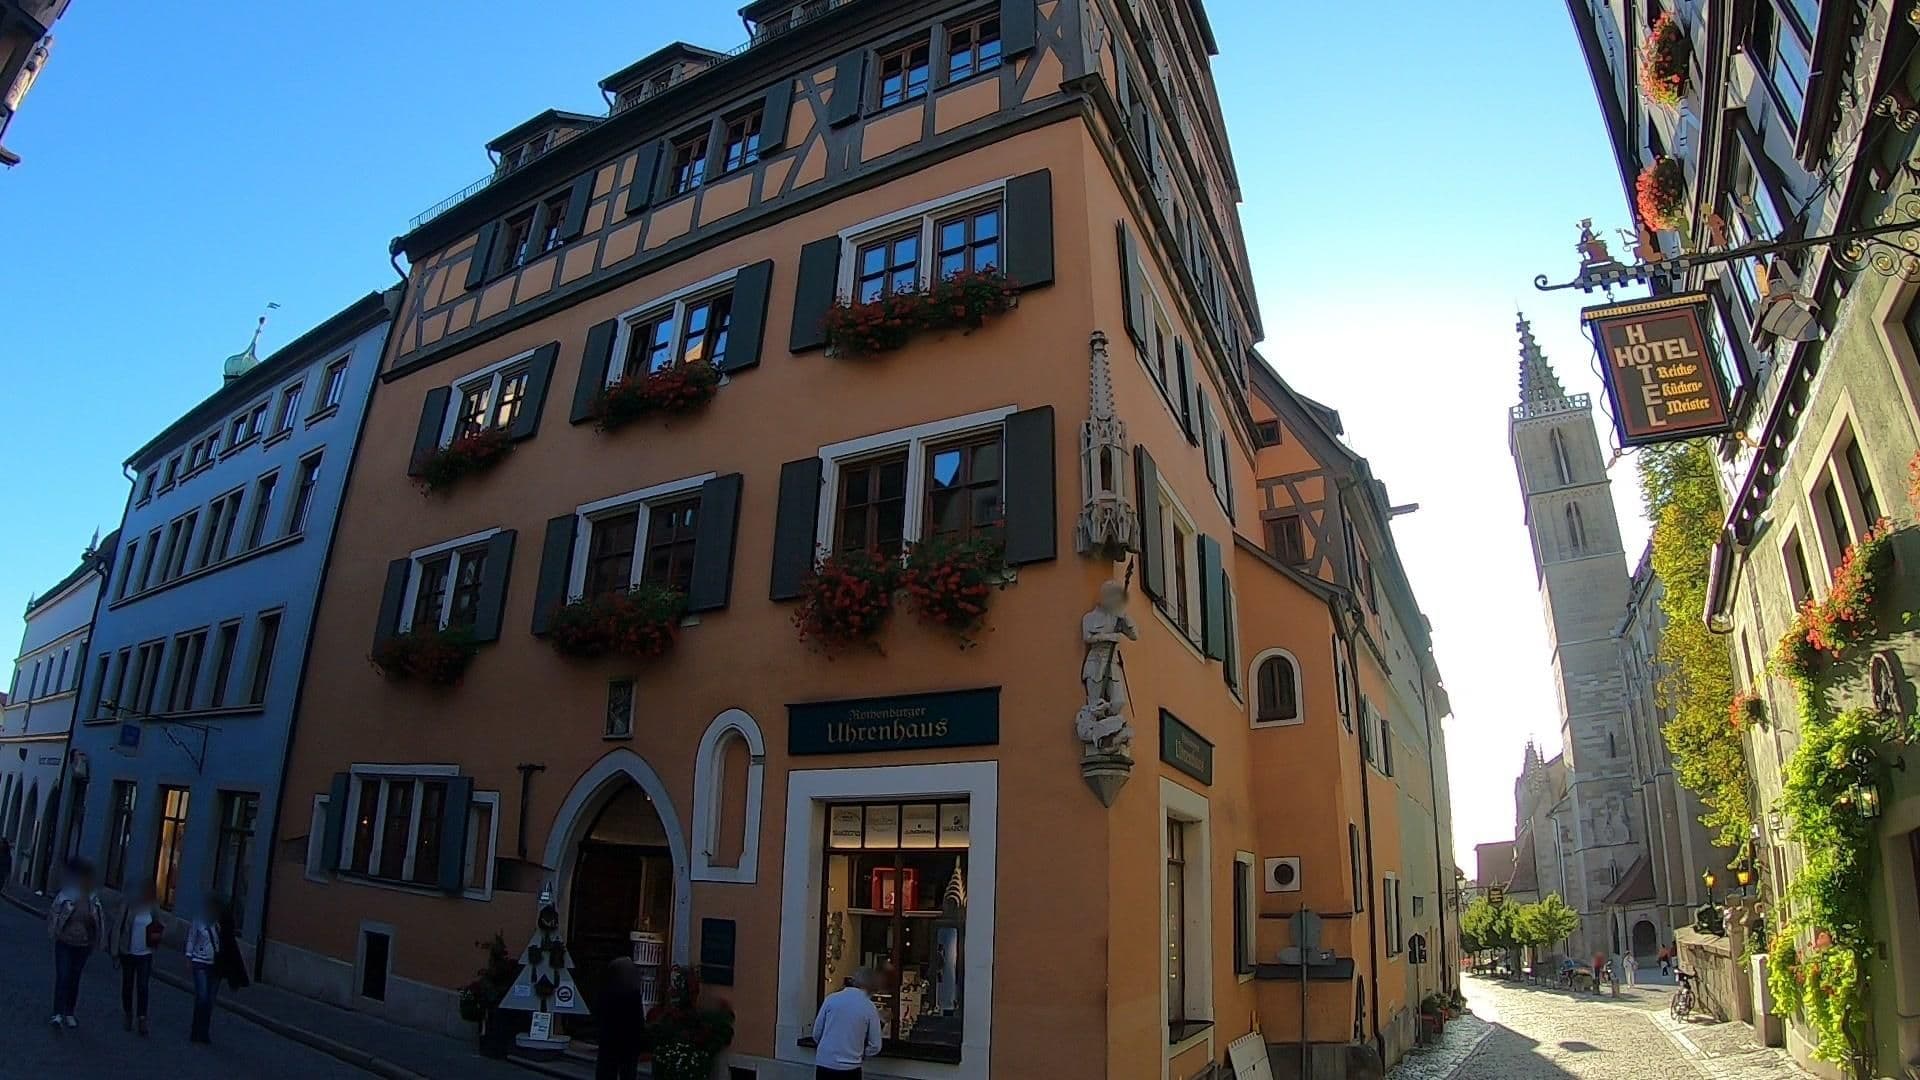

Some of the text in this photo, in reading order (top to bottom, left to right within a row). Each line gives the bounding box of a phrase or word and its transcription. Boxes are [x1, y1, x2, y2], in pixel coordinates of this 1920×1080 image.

[1614, 337, 1699, 367] HOTEL
[1625, 323, 1667, 427] HOTEL
[1666, 397, 1711, 415] Meister
[827, 717, 949, 744] Uhrenhaus
